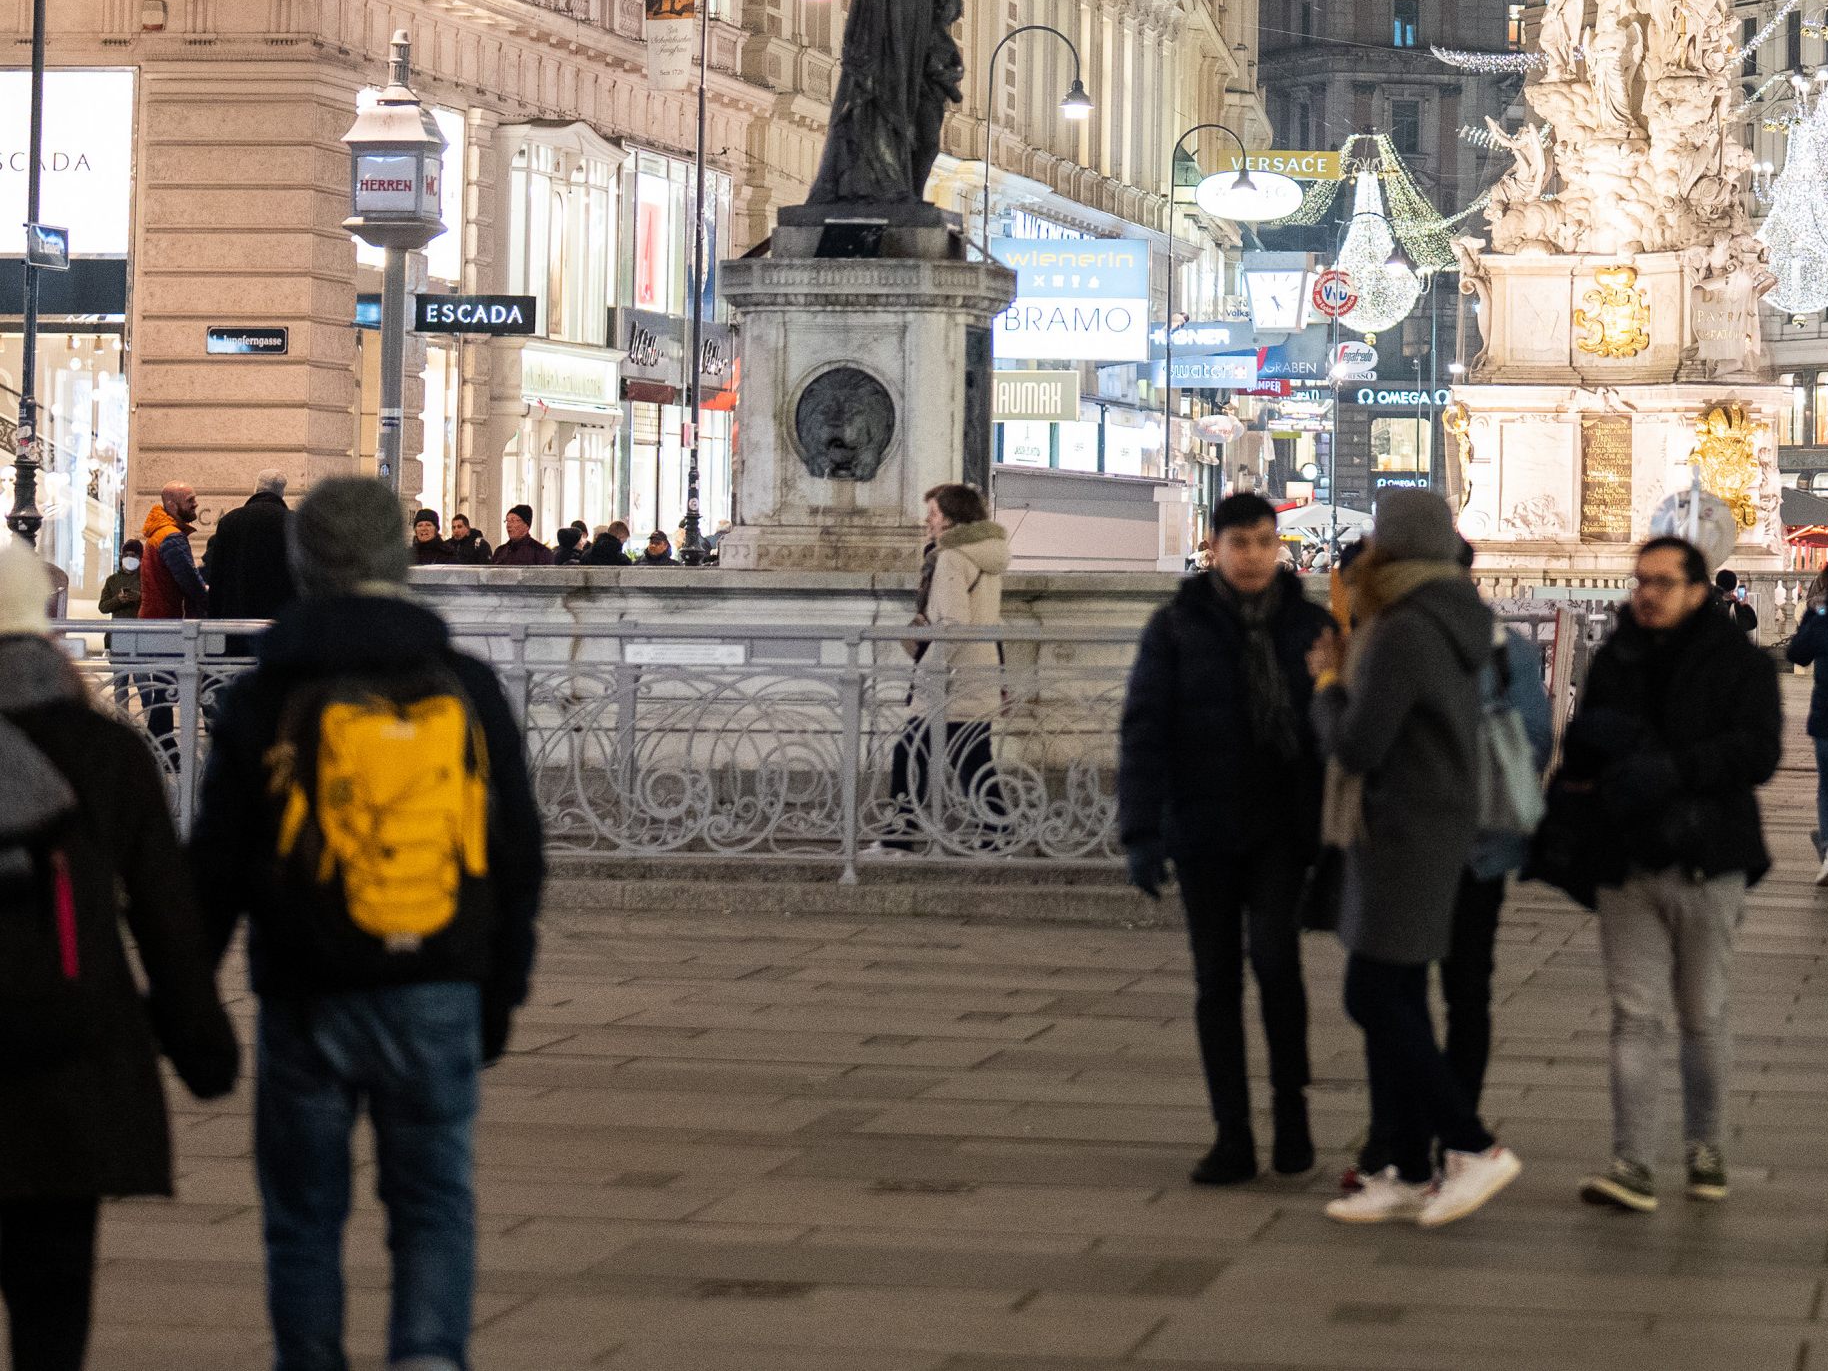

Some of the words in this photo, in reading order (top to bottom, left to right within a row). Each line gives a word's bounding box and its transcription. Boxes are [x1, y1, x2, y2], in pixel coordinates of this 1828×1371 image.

[1231, 156, 1328, 173] VERSACE
[360, 179, 412, 192] HERREN
[426, 303, 523, 325] ESCADA
[1005, 307, 1131, 333] BRAMO
[1264, 362, 1317, 374] GRABEN
[1377, 391, 1431, 405] OMEGA
[1387, 479, 1416, 488] OMEGA
